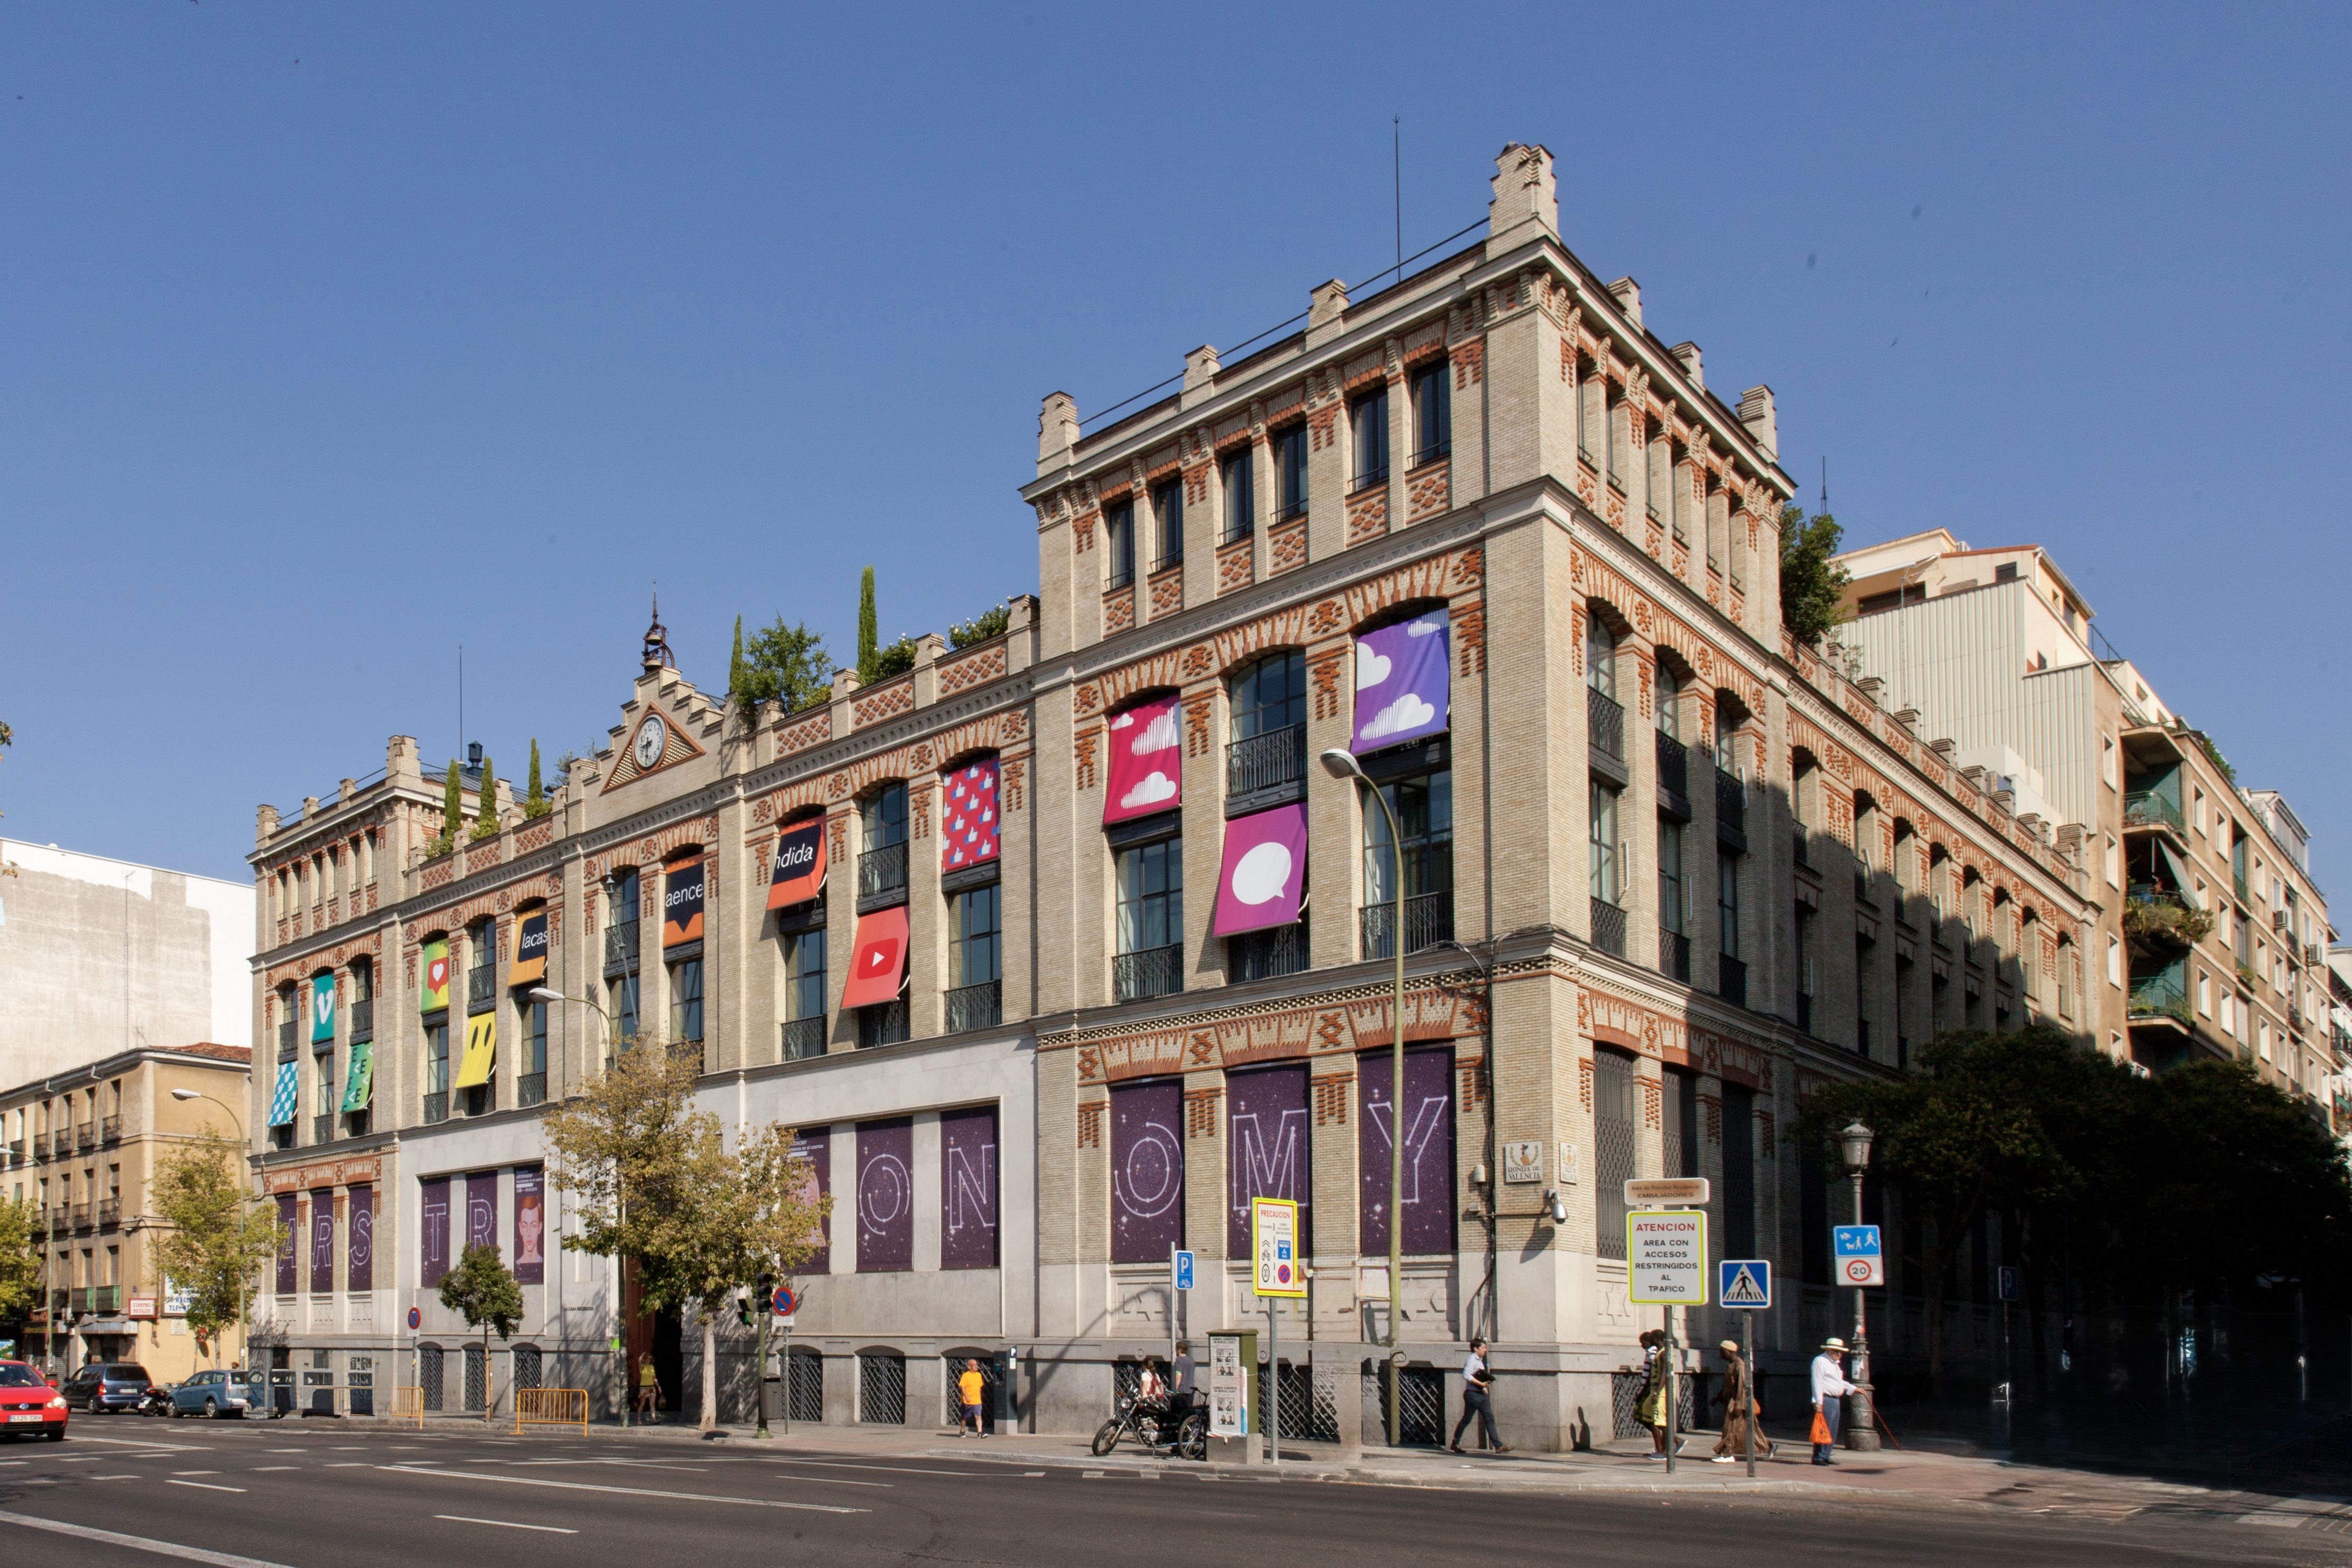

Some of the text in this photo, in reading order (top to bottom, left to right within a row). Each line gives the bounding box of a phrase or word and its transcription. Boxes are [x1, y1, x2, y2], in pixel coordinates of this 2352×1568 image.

[665, 884, 703, 907] aence
[1508, 1172, 1540, 1180] VALENCIA
[1260, 1210, 1290, 1218] PRECAUCION
[1181, 1257, 1189, 1273] P
